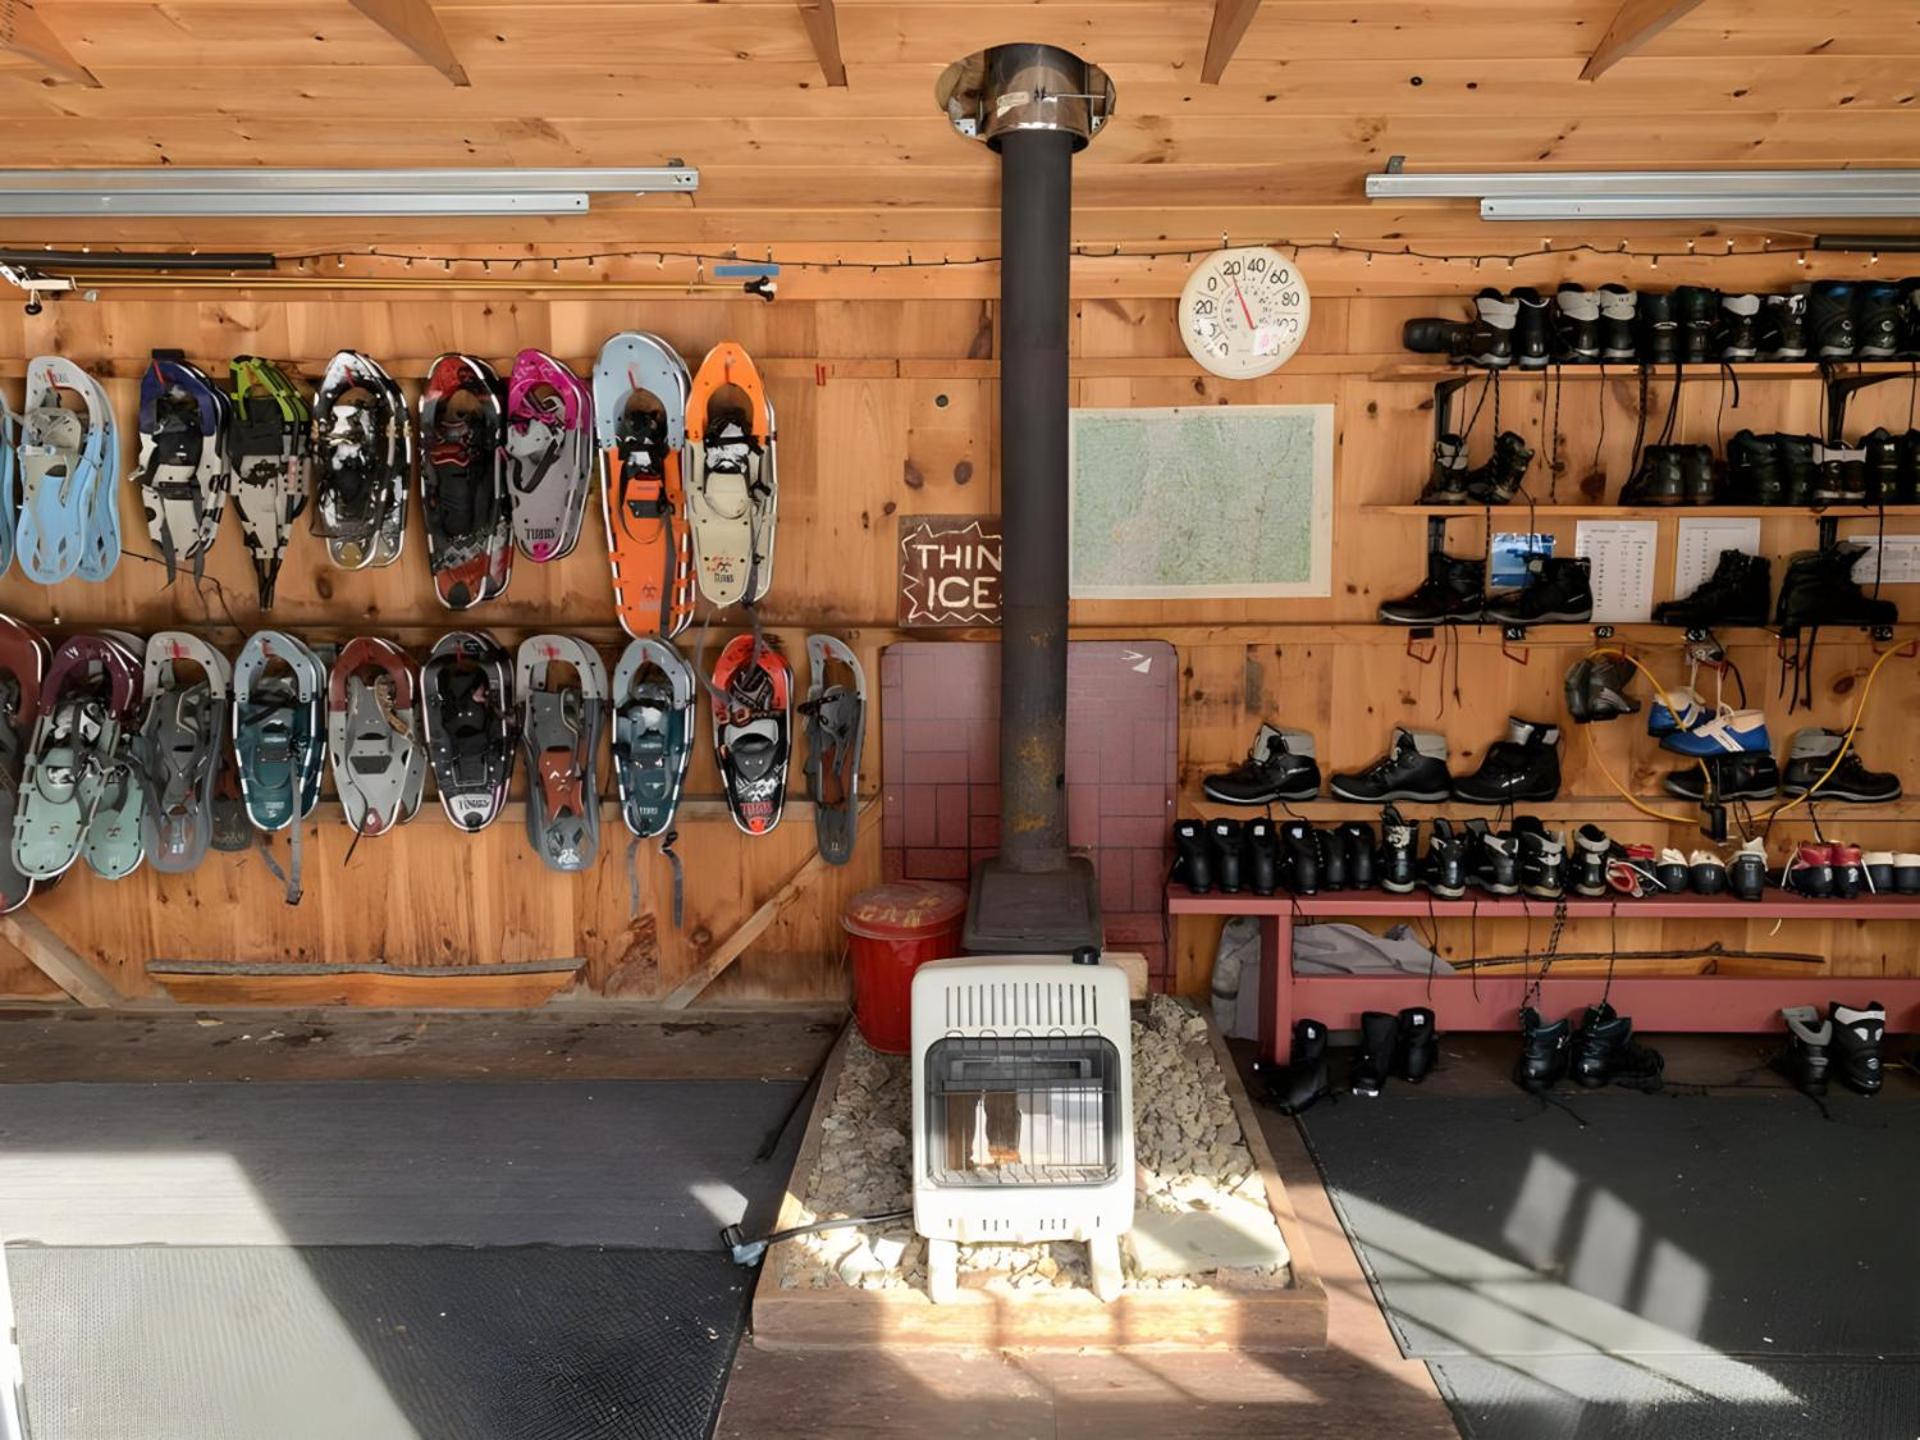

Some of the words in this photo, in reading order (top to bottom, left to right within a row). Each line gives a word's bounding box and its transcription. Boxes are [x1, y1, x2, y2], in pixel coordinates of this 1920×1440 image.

[1223, 260, 1241, 276] 20
[1247, 257, 1266, 273] 40
[1207, 277, 1217, 291] 0
[1269, 269, 1289, 284] 60
[1195, 299, 1213, 315] 20
[1281, 292, 1300, 307] 80
[912, 544, 1002, 572] THIN
[928, 576, 997, 611] ICE
